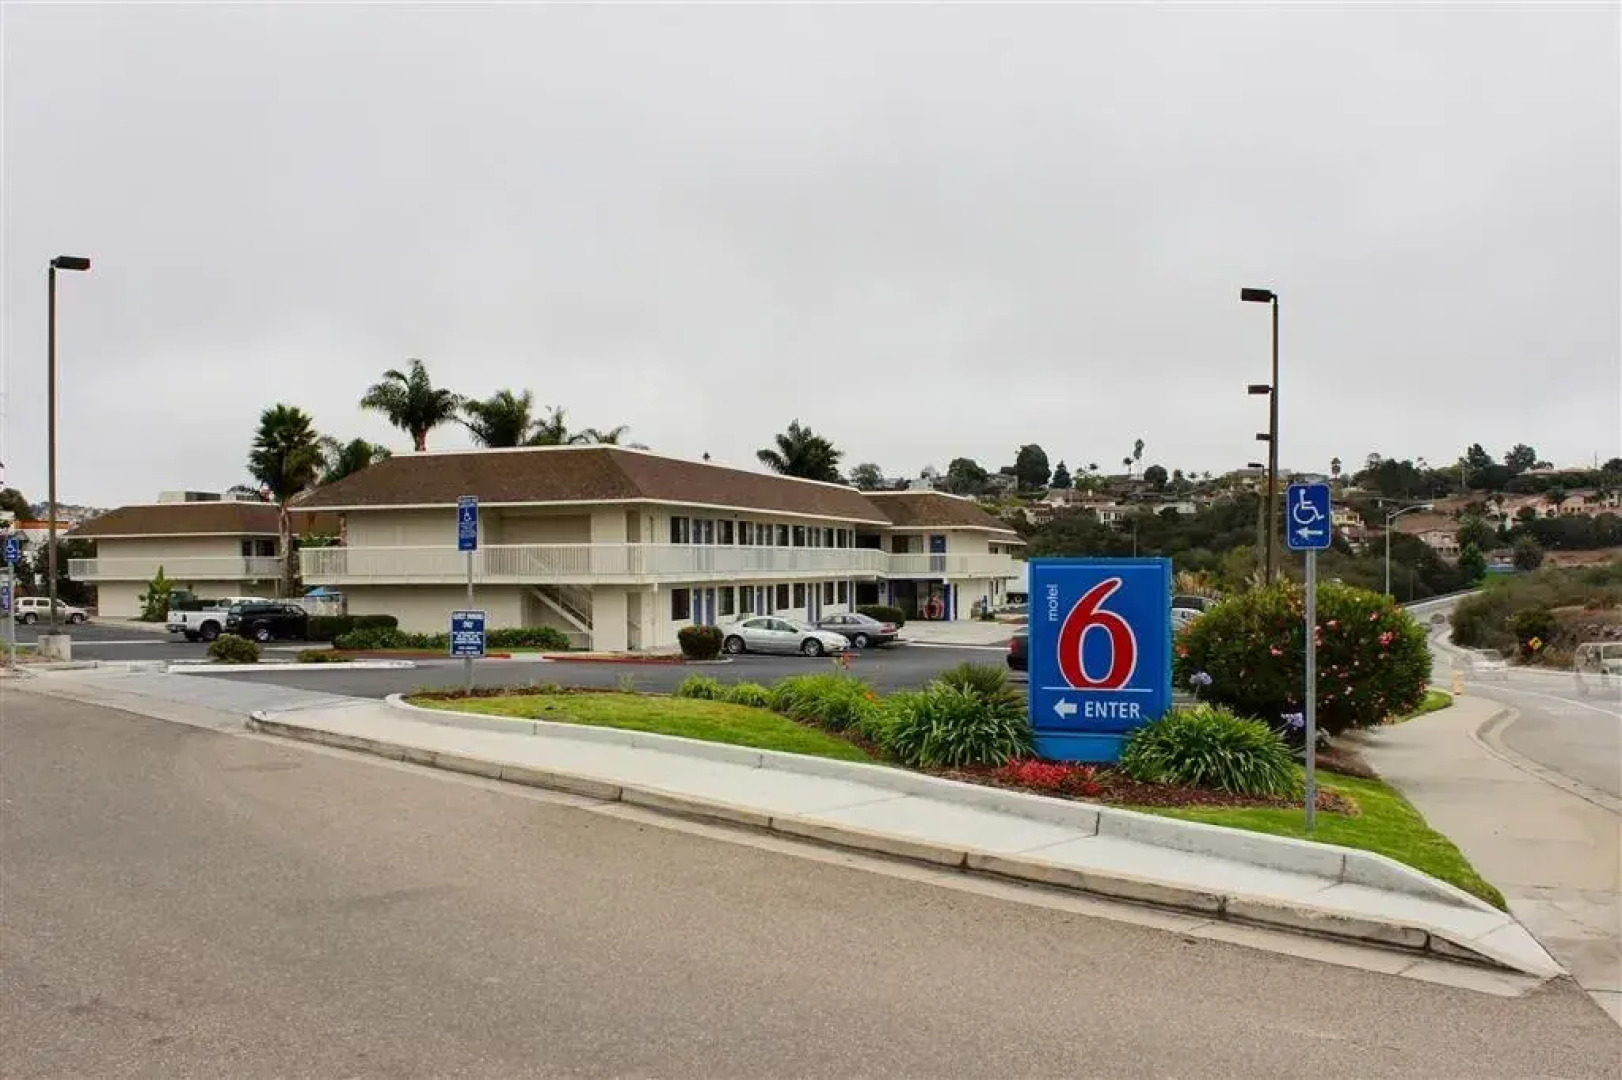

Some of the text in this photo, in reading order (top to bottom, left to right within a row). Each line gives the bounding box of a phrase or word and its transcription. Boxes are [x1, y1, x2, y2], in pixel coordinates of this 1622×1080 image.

[1047, 584, 1059, 622] motel
[1057, 577, 1138, 691] 6
[1084, 701, 1140, 719] ENTER
